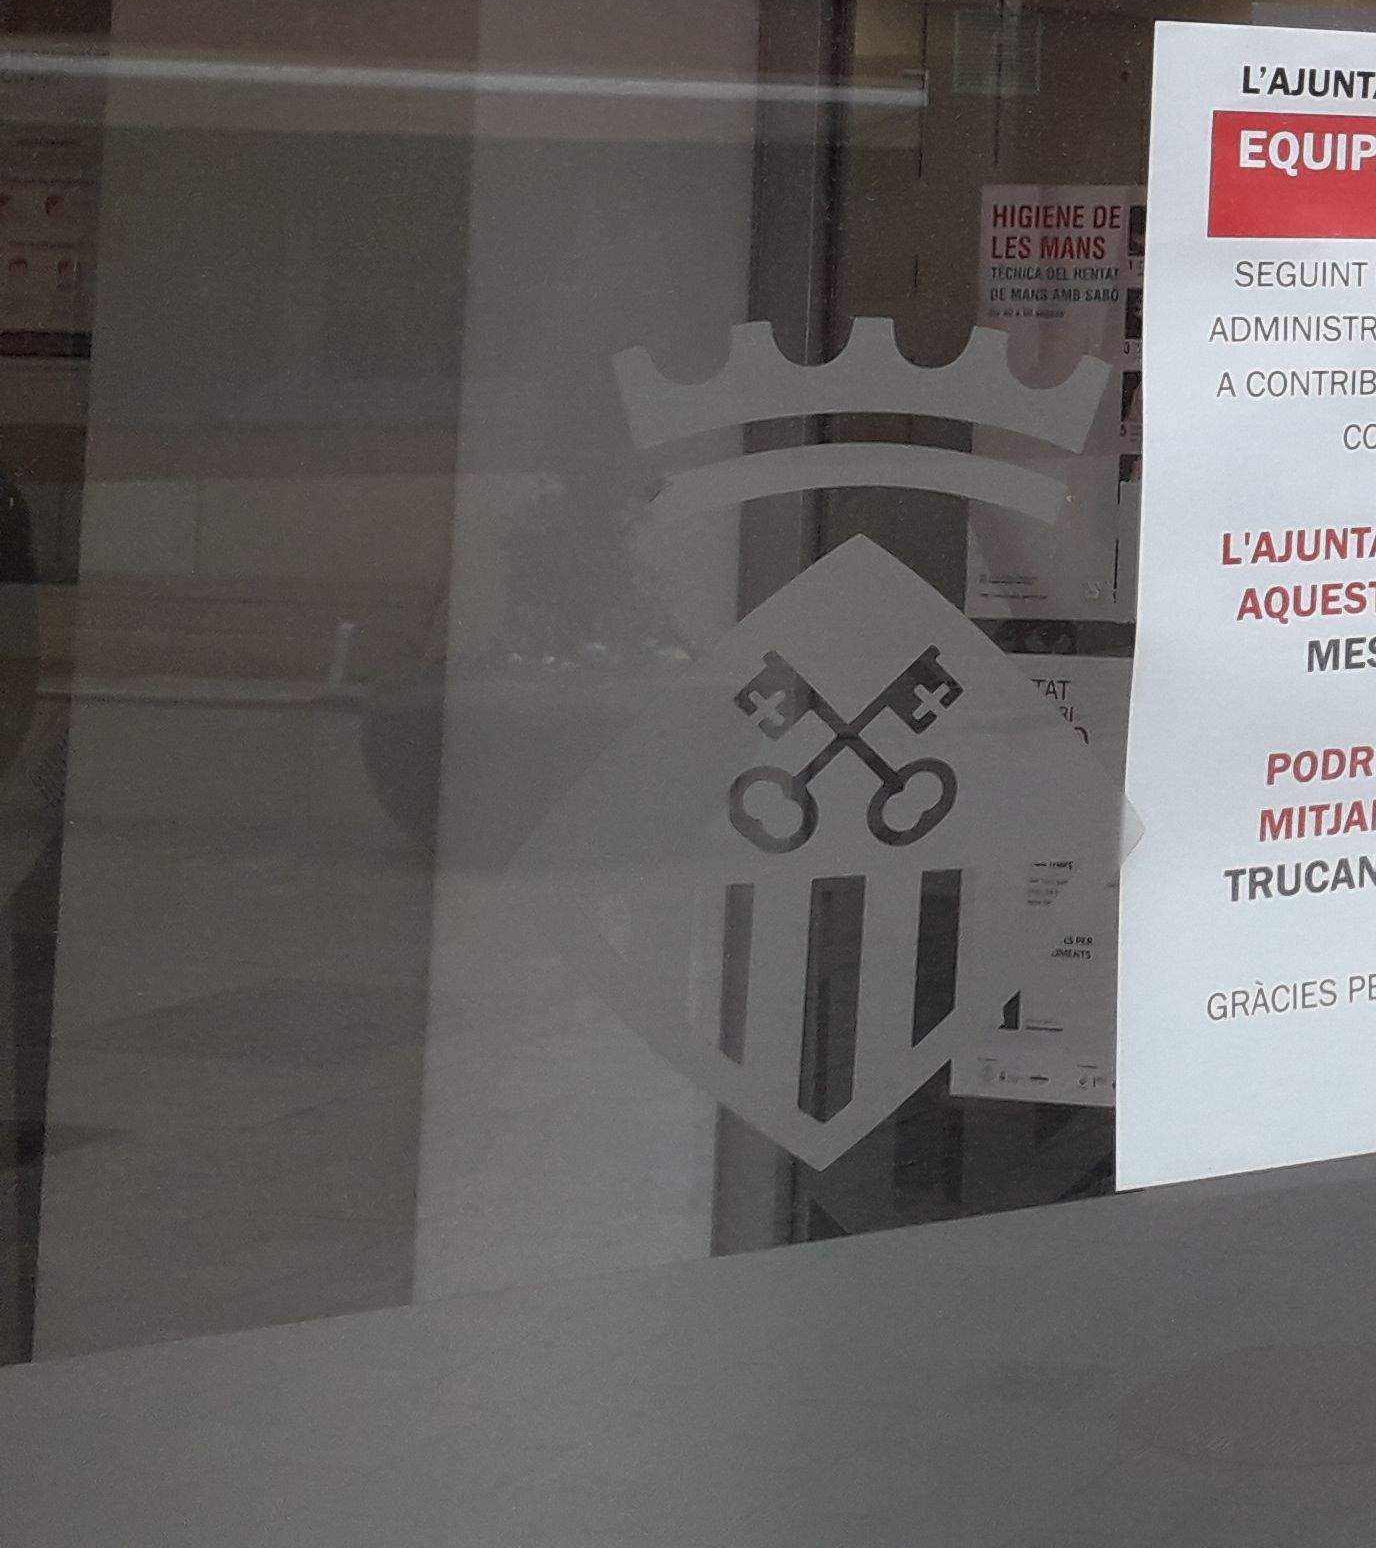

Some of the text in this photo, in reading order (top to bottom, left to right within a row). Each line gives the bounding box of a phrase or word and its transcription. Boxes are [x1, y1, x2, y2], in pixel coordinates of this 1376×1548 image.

[992, 204, 1121, 229] HIGIENE DE
[991, 236, 1106, 260] LES MANS
[1234, 260, 1368, 287] SEGUINT
[1216, 371, 1236, 397] A
[1206, 978, 1337, 1020] GRÀCIES
